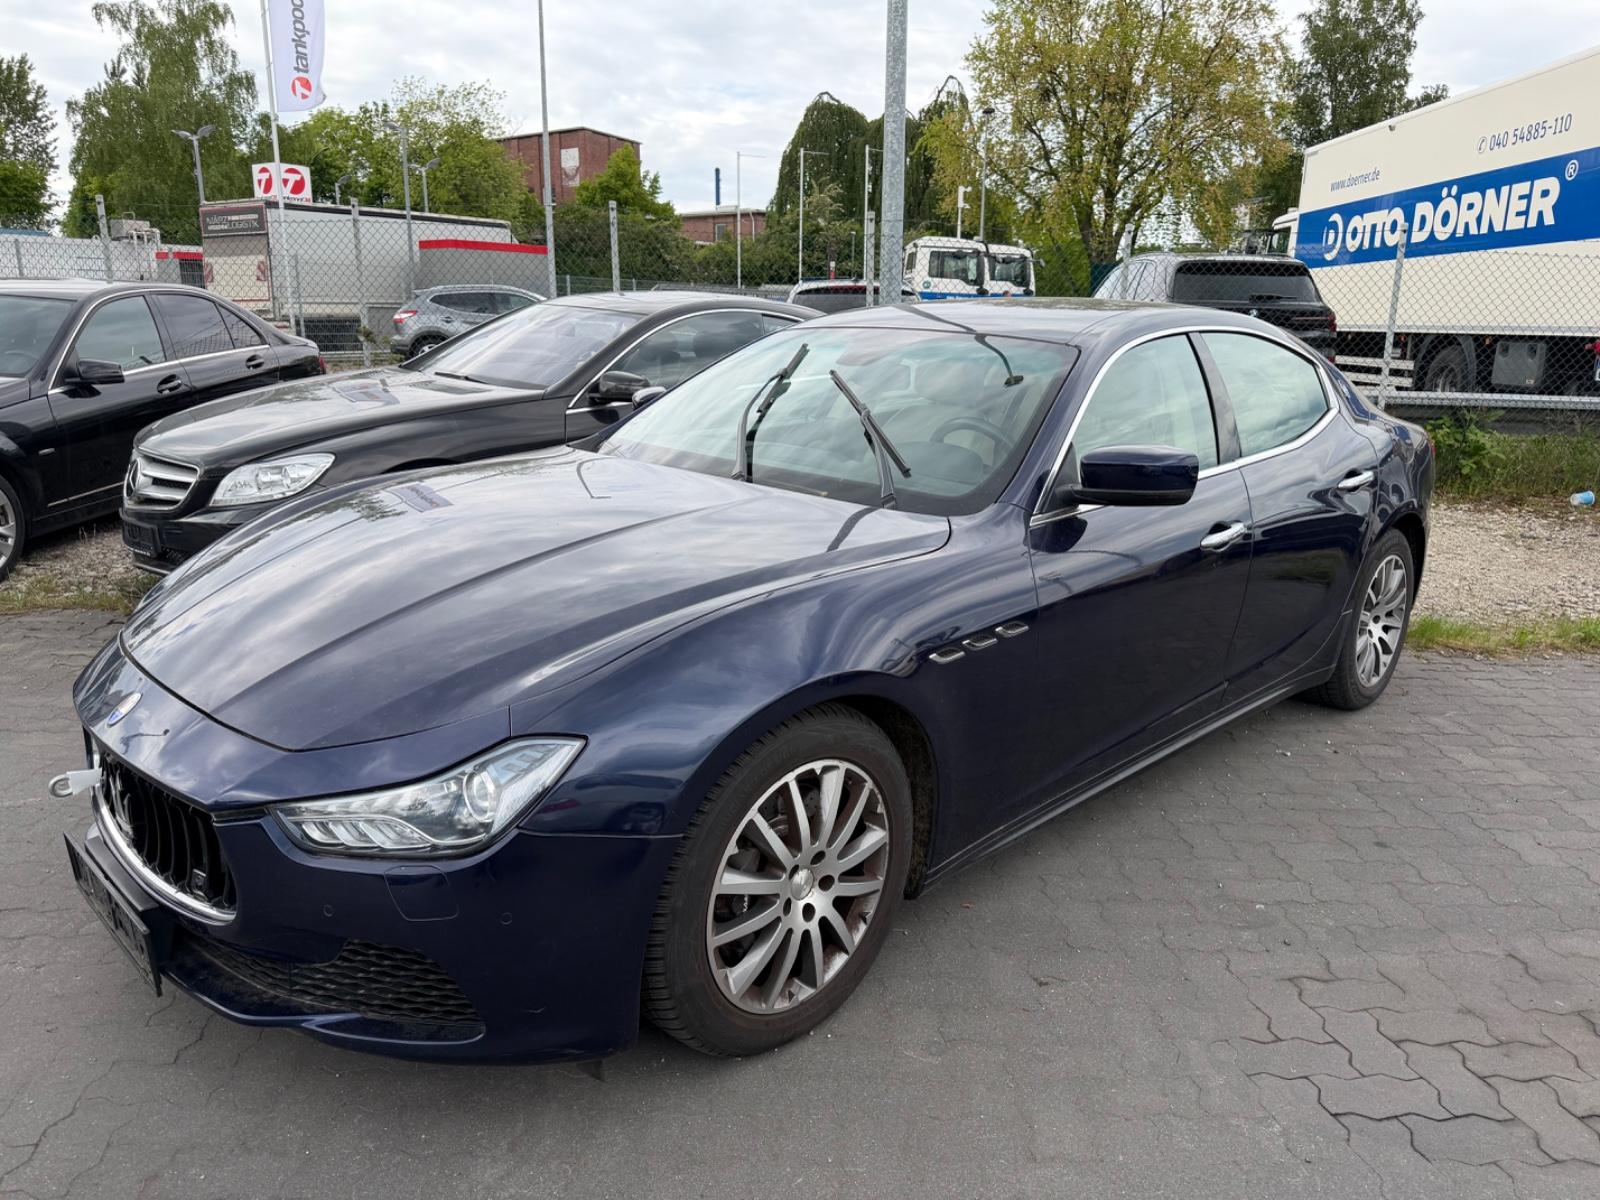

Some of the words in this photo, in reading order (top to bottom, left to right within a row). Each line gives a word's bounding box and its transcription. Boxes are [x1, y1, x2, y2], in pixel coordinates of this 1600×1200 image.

[1489, 130, 1508, 151] 040
[1512, 114, 1573, 146] 54885-110
[1330, 166, 1380, 192] www.doerner.de
[1346, 207, 1405, 252] OTTO
[1411, 176, 1560, 243] DÖRNER
